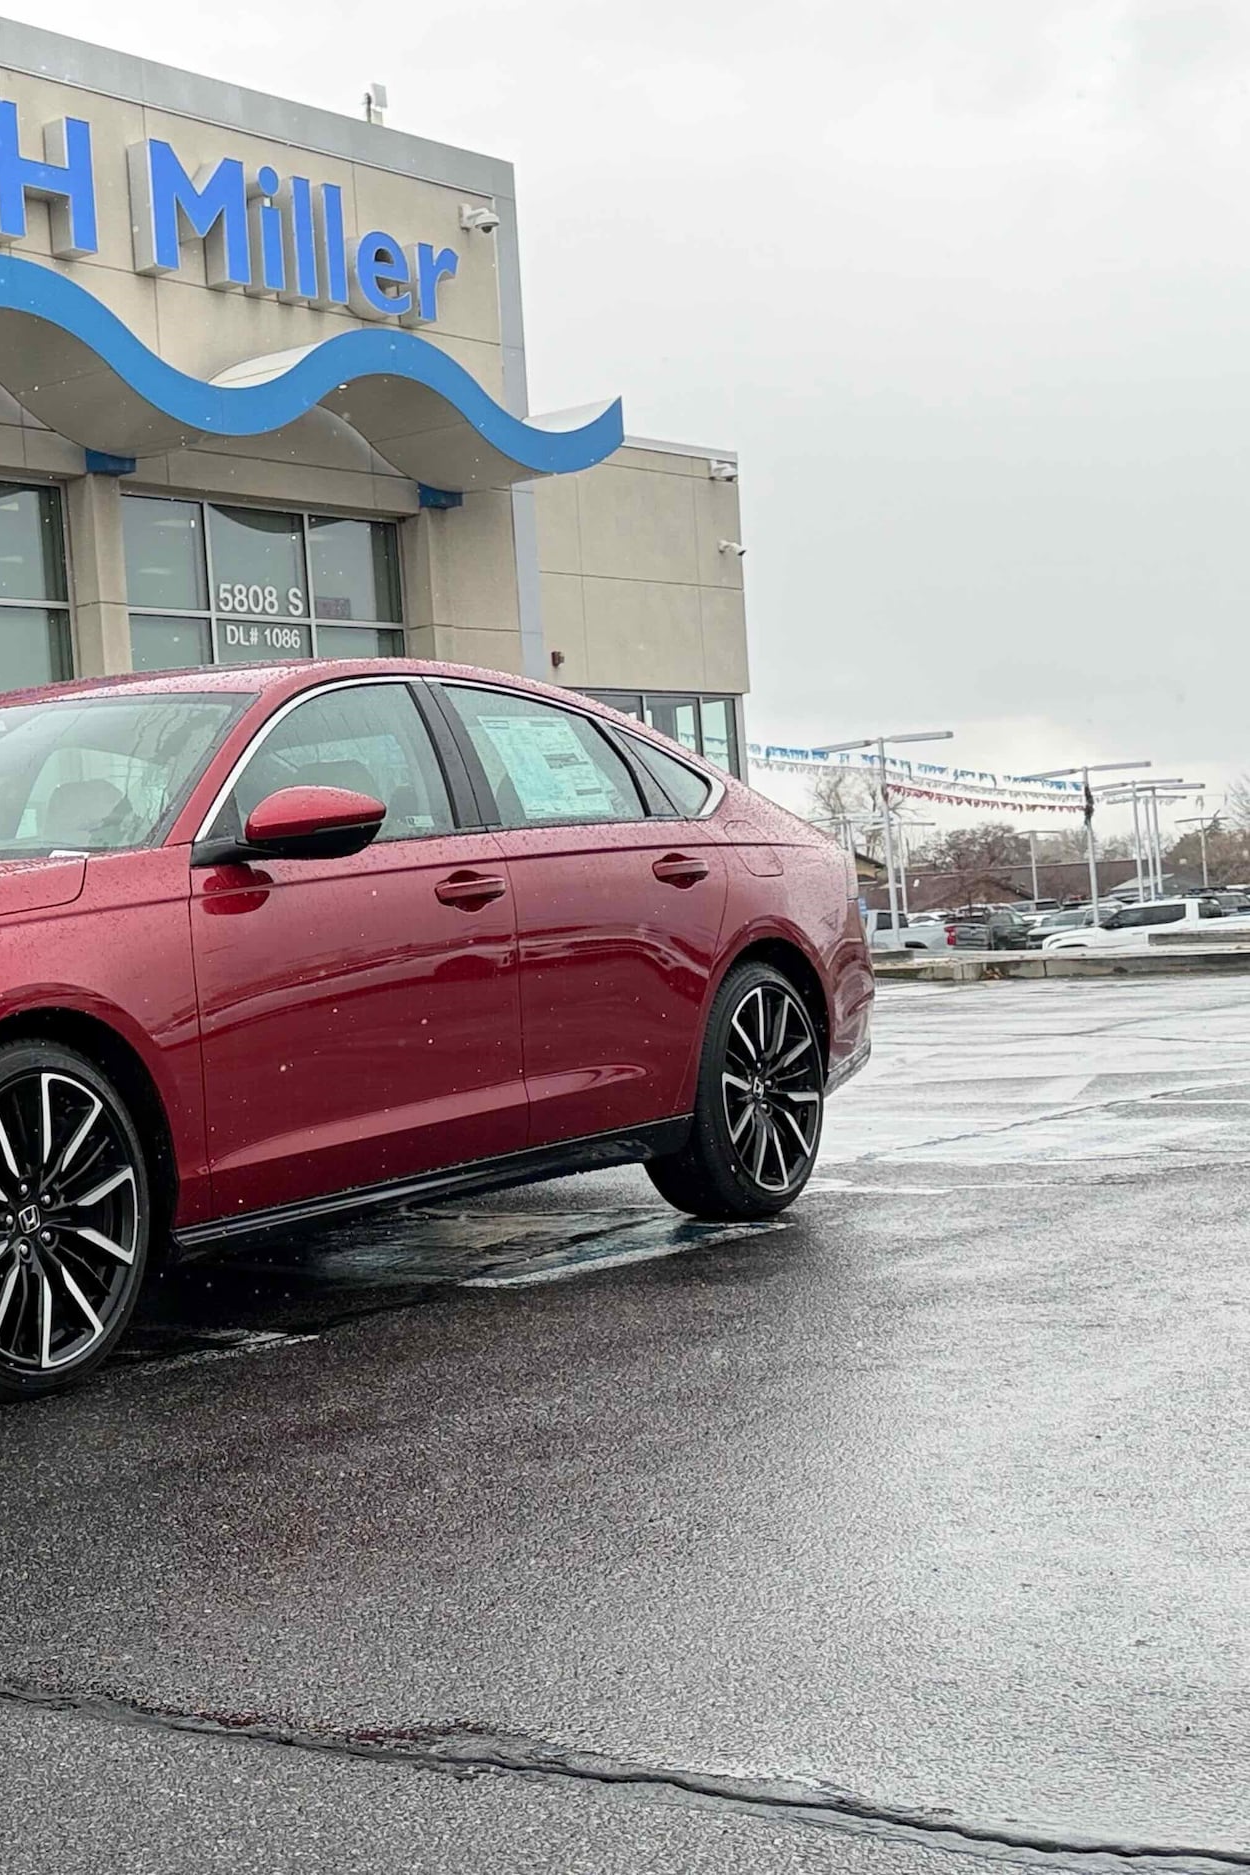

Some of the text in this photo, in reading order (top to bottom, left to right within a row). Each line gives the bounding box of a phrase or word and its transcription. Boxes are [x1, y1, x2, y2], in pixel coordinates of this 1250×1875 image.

[140, 138, 459, 324] Miller
[218, 583, 279, 615] 5808
[287, 586, 304, 616] S
[225, 624, 301, 649] DL# 1086
